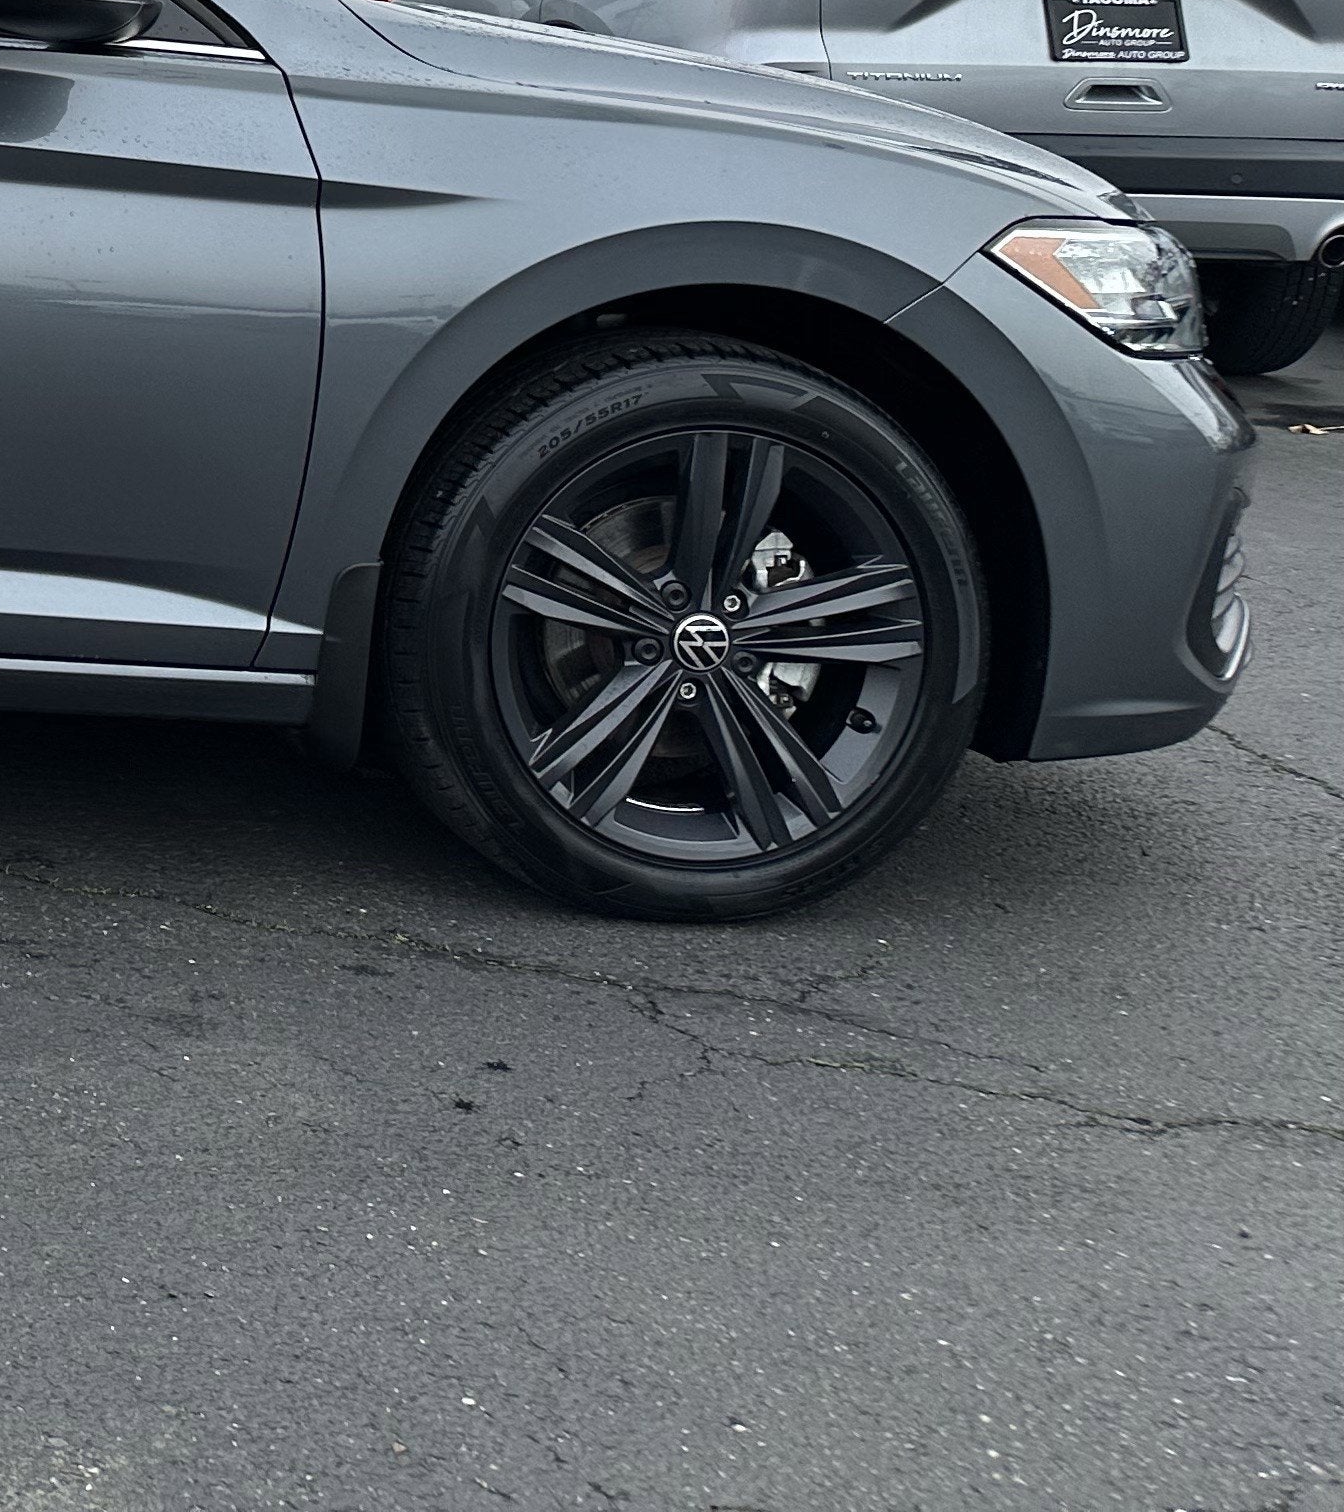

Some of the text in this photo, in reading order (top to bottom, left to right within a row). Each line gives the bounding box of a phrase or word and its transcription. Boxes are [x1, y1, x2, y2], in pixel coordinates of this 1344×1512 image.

[1062, 9, 1174, 45] Dinsmore
[1098, 39, 1156, 47] AUTO GROUP
[1062, 48, 1186, 59] Dinsmore AUTO GROUP
[846, 71, 963, 82] TITANIUM
